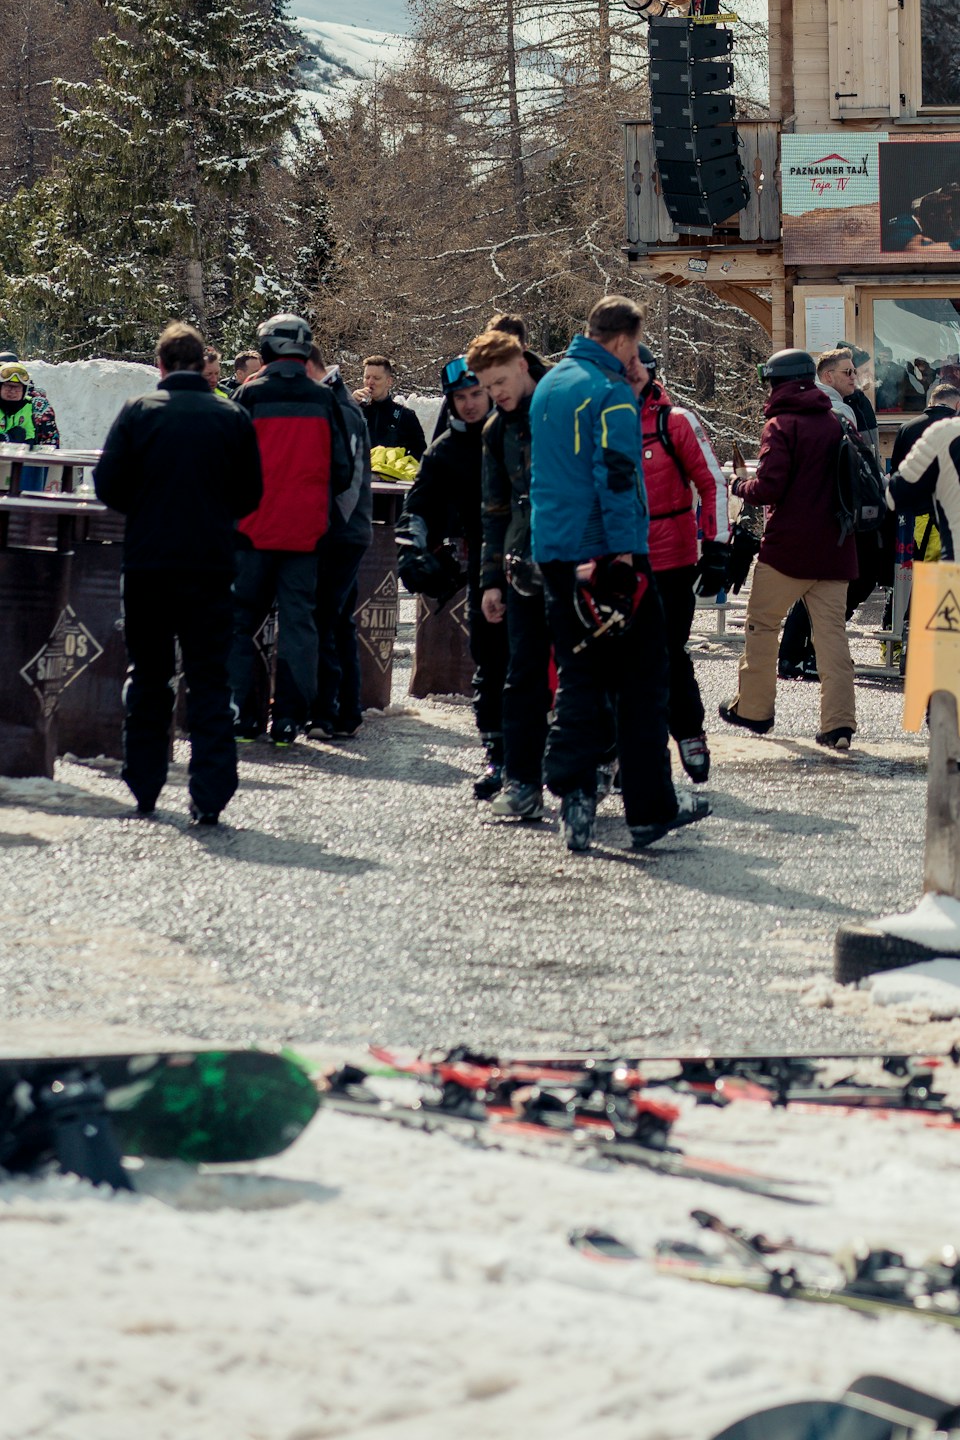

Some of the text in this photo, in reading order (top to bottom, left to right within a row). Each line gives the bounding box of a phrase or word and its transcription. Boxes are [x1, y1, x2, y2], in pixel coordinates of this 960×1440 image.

[790, 166, 844, 176] PAZNAUNER
[810, 177, 851, 196] Taja TV
[360, 608, 396, 628] SALIT
